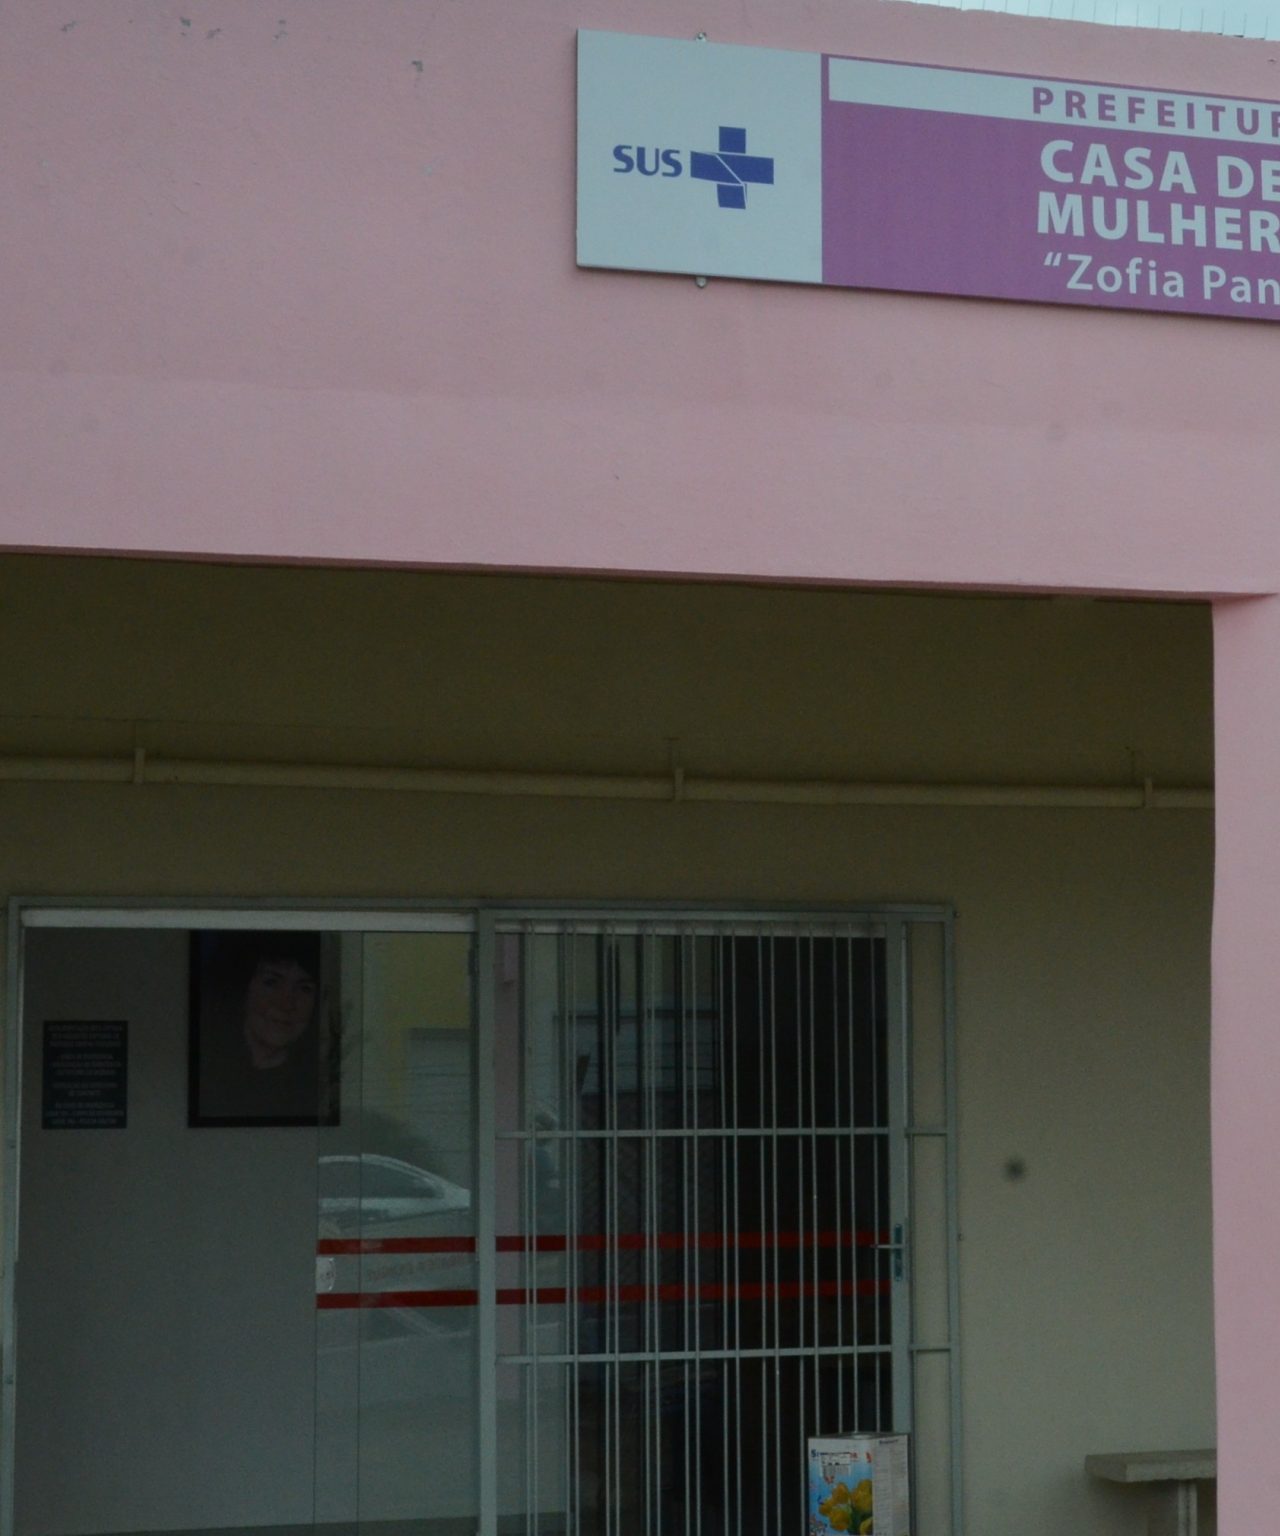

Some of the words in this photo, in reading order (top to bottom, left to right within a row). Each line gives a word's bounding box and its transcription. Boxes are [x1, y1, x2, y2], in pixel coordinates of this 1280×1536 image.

[612, 144, 683, 177] SUS
[1039, 139, 1197, 195] CASA
[1043, 251, 1185, 299] “Zofia
